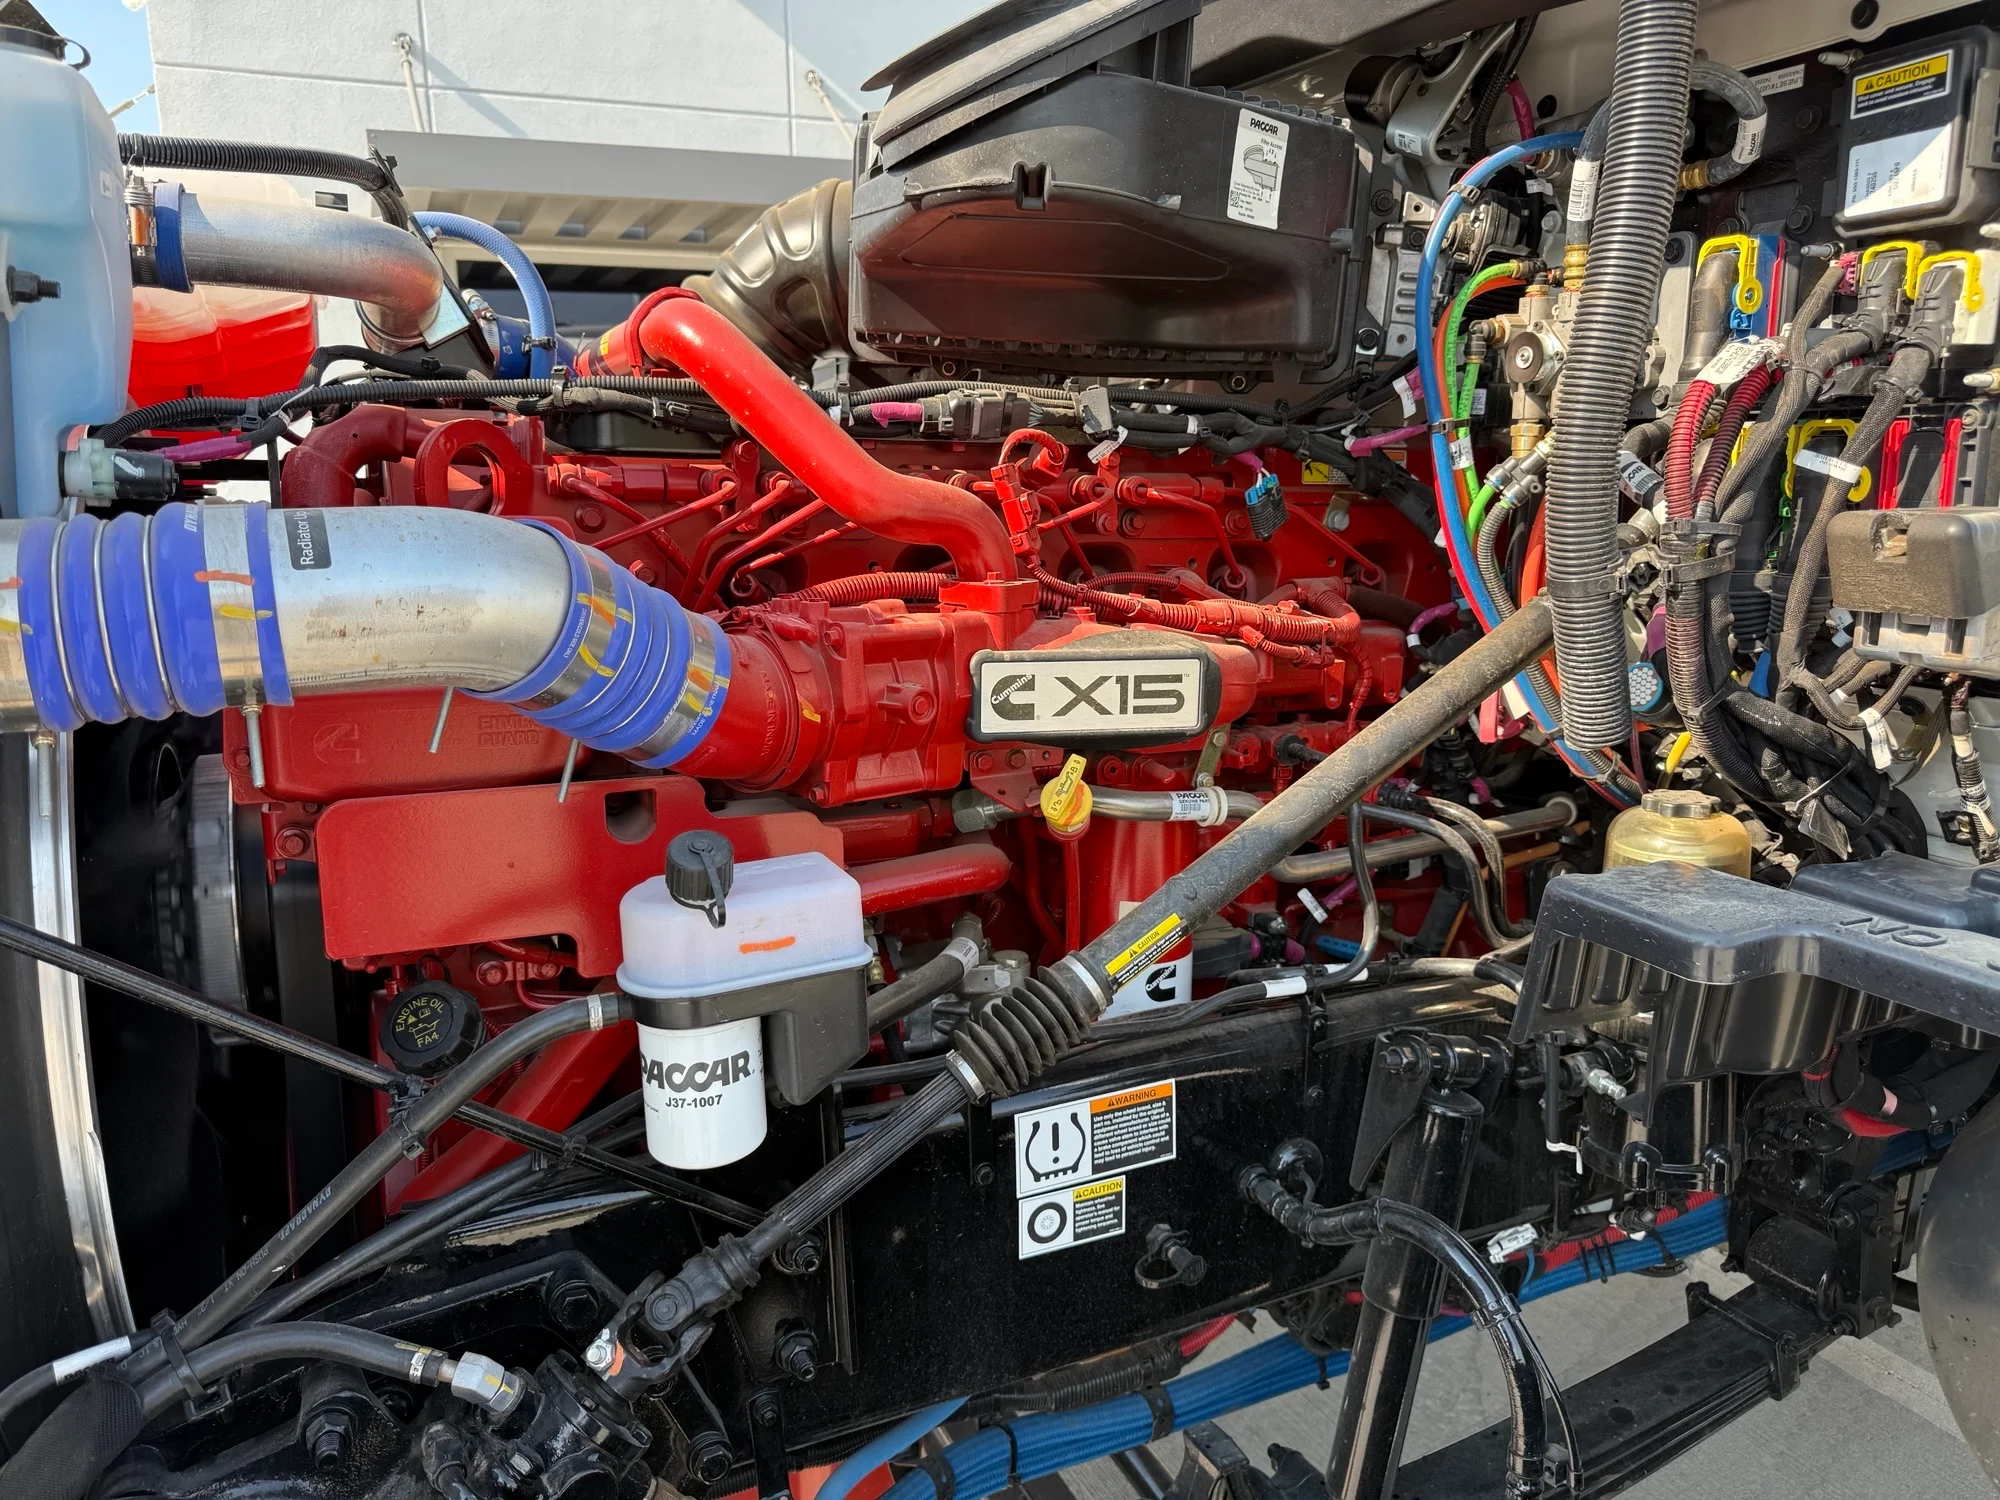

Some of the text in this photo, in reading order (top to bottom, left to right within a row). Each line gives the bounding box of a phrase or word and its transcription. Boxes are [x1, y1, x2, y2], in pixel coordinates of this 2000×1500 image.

[1875, 63, 1930, 88] CAUTION
[1250, 118, 1279, 136] PACCAR
[297, 521, 315, 565] Radiator
[991, 673, 1033, 705] Cummins
[1051, 674, 1185, 717] X15
[478, 714, 543, 731] ENVIR
[766, 710, 776, 723] IN
[479, 730, 540, 747] GUARD
[1136, 930, 1161, 950] CAUTION
[1145, 965, 1175, 991] Cummins
[395, 997, 444, 1032] ENGINE OIL
[416, 1031, 439, 1048] FA4
[665, 1094, 723, 1108] J37-1007
[1115, 1089, 1156, 1106] WARNING
[1093, 1114, 1103, 1122] Use
[1104, 1112, 1114, 1121] only
[1122, 1107, 1136, 1115] wheel
[1093, 1121, 1103, 1129] part
[1112, 1114, 1132, 1124] installed
[1132, 1112, 1138, 1120] by
[1147, 1106, 1164, 1116] original
[1093, 1131, 1113, 1141] different
[1113, 1128, 1127, 1136] wheel
[1128, 1124, 1141, 1132] brand
[1148, 1120, 1157, 1128] size
[1158, 1117, 1170, 1125] could
[1093, 1124, 1118, 1135] equipment
[1093, 1138, 1108, 1147] cause
[1109, 1135, 1121, 1143] valve
[1122, 1132, 1133, 1140] stem
[1159, 1123, 1169, 1131] with
[1094, 1151, 1104, 1159] lead
[1110, 1147, 1120, 1155] loss
[1127, 1141, 1143, 1150] vehicle
[1144, 1137, 1160, 1146] control
[1098, 1144, 1111, 1152] brake
[1111, 1137, 1137, 1149] component
[1138, 1133, 1151, 1142] which
[1152, 1130, 1165, 1138] could
[1104, 1154, 1115, 1162] lead
[1121, 1148, 1141, 1159] personal
[1082, 1181, 1122, 1197] CAUTION
[280, 1186, 331, 1241] DYNADRAFT
[236, 1246, 269, 1281] PUSH-ON
[224, 1277, 234, 1292] XT
